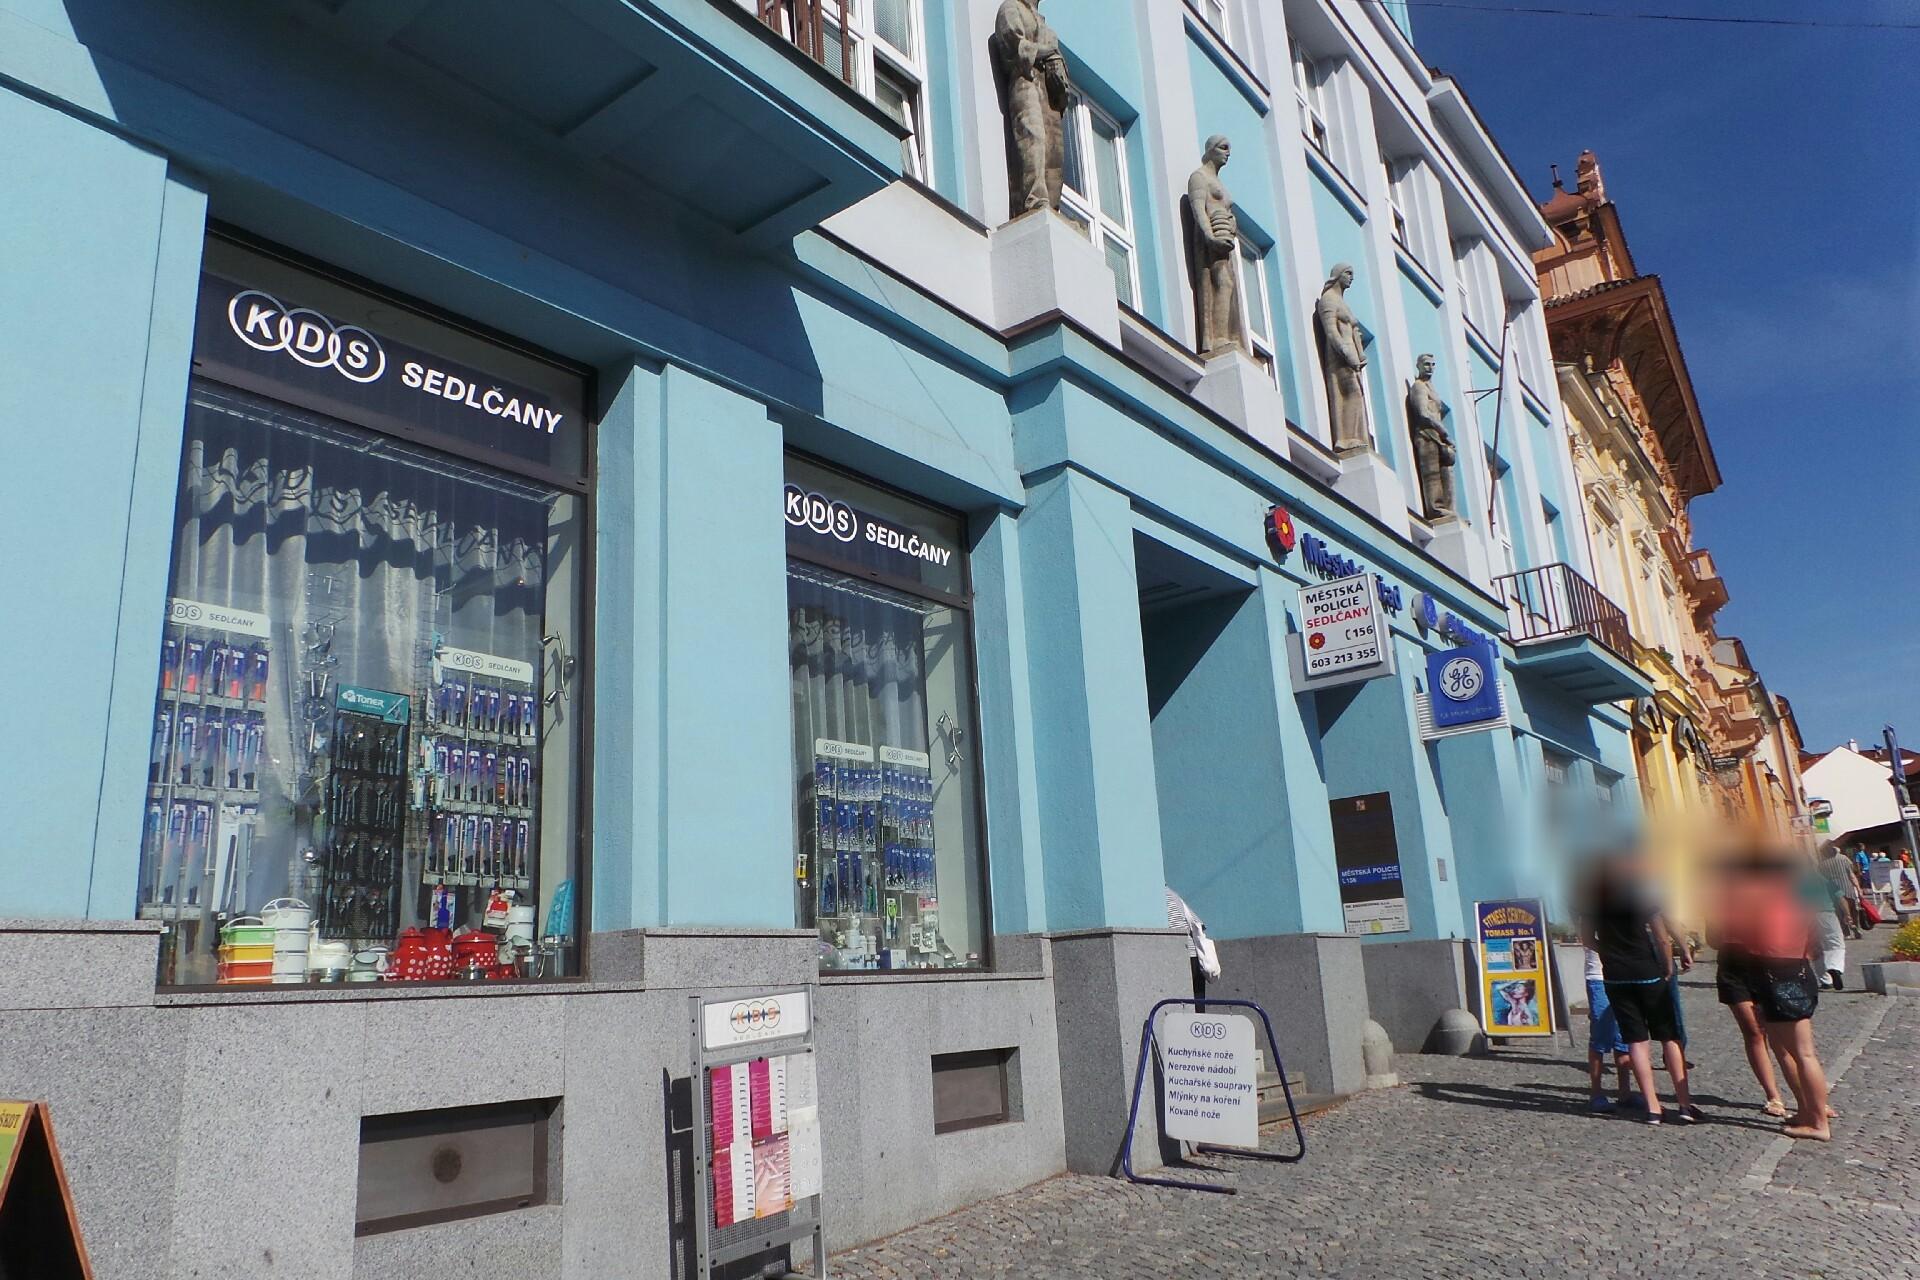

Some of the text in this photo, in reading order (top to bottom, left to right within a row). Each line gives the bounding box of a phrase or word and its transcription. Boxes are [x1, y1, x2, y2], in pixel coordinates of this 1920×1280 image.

[243, 302, 563, 434] KDS SEDLČANY
[786, 491, 951, 567] KDS SEDLČANY
[1305, 580, 1364, 605] MĚSTSKÁ
[1313, 596, 1360, 615] POLICIE
[1306, 606, 1370, 629] SEDLČANY
[1352, 625, 1374, 638] 156
[1311, 647, 1377, 669] 603 213 355
[1372, 865, 1399, 874] POLICIE
[1167, 1047, 1234, 1060] Kuchyňské nože
[1168, 1061, 1236, 1075] Nerezové nádobí
[1168, 1076, 1253, 1093] Kuchařské soupravy
[1168, 1090, 1241, 1106] Mlýnky na koření
[1169, 1105, 1221, 1119] Kované nože
